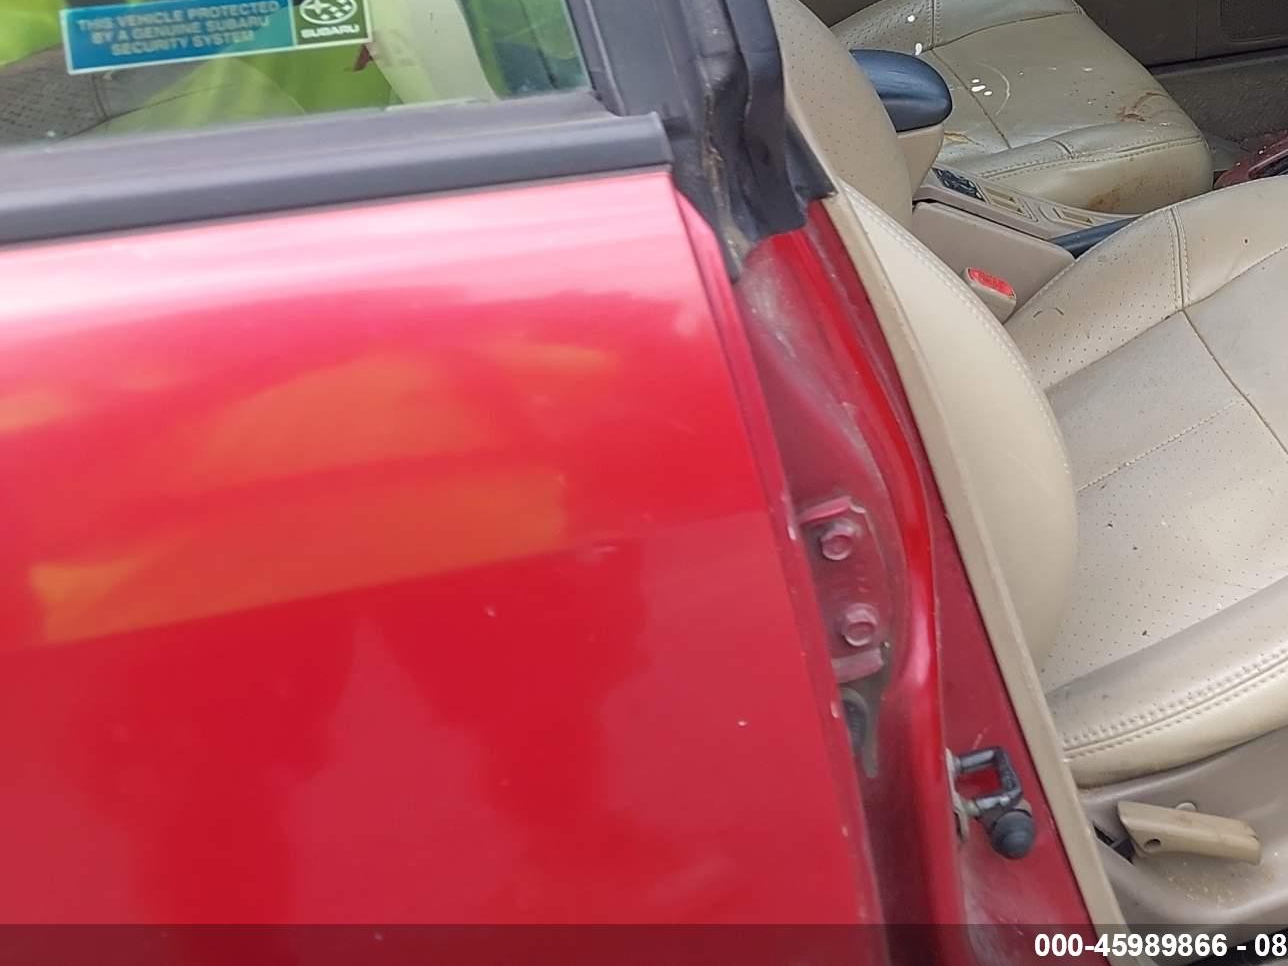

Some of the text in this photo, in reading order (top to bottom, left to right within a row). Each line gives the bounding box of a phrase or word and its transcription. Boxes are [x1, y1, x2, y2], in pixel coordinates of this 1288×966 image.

[77, 0, 281, 32] THIS VEHICLE PROTECTED
[91, 16, 270, 45] BY A GENUINE SUBARU
[111, 30, 255, 56] SECURITY SYSTEM
[300, 24, 361, 38] SUBARU
